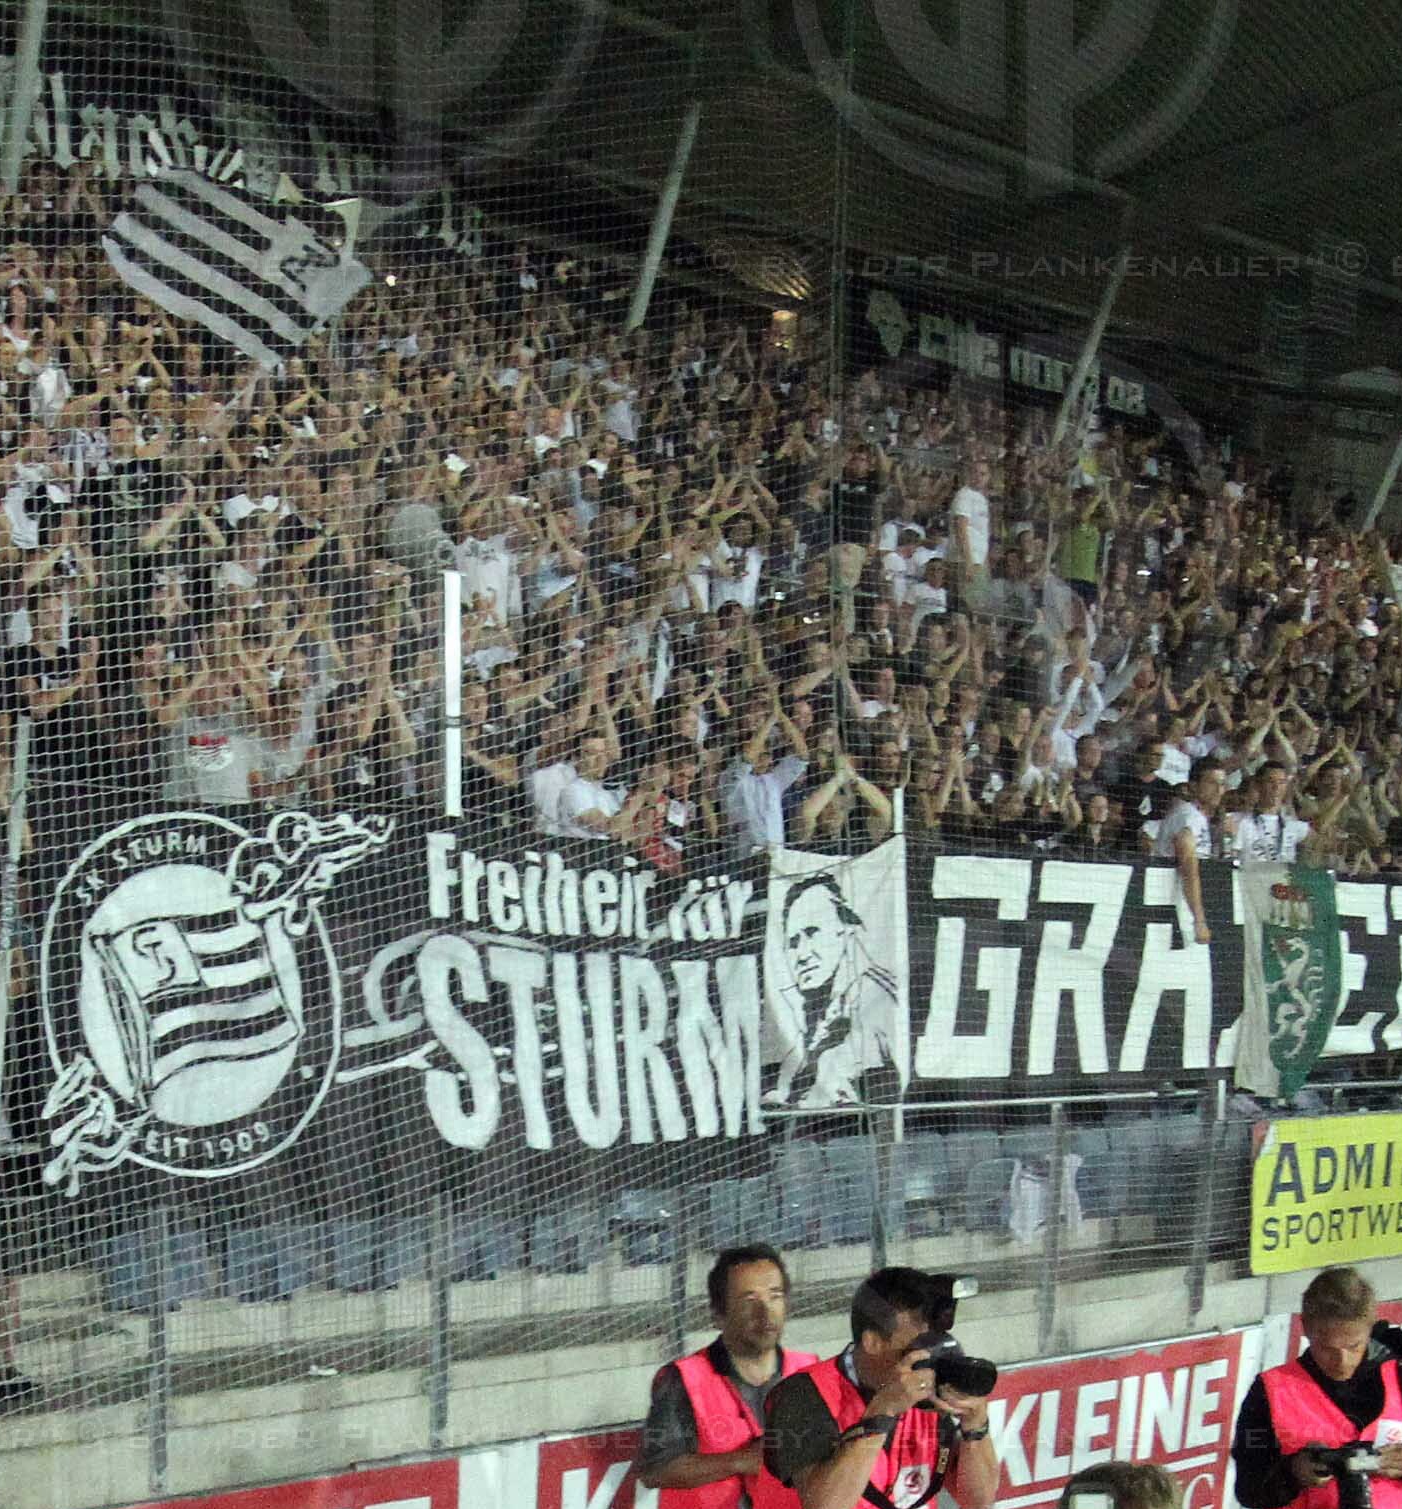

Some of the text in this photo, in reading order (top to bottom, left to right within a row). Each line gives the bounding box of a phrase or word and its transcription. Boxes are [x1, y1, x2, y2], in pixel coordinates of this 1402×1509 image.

[111, 830, 208, 871] STURM
[426, 832, 657, 939] Freiheit
[417, 933, 766, 1150] STURM
[203, 1121, 271, 1161] 1909
[987, 1358, 1230, 1488] KLEINE
